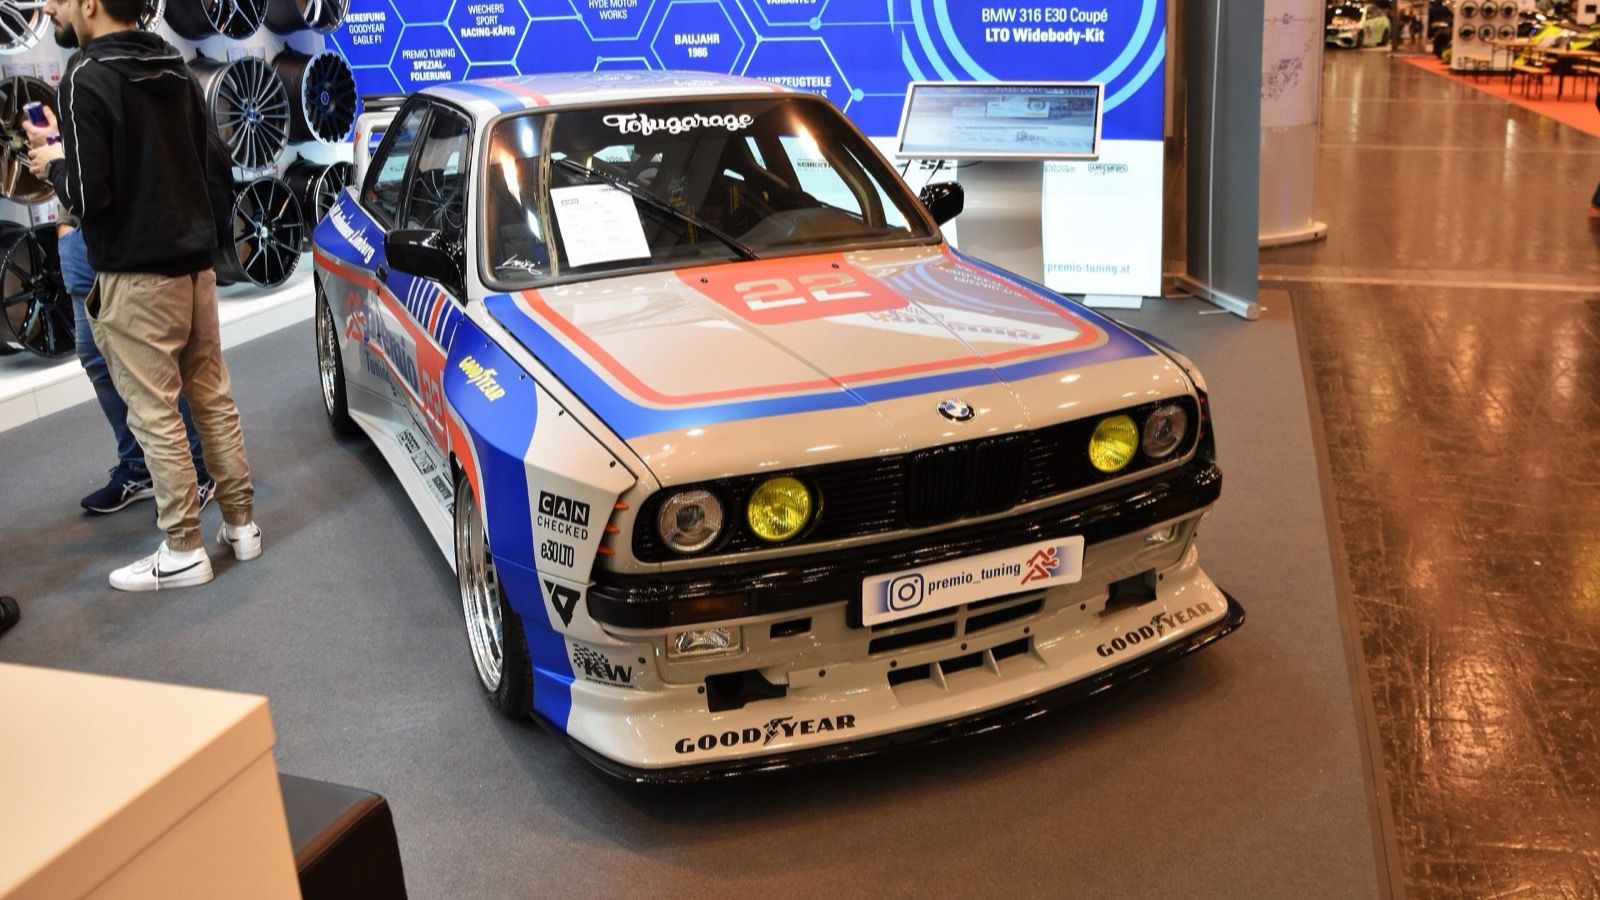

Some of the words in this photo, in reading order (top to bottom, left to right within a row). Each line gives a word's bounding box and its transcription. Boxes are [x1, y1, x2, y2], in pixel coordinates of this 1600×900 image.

[468, 4, 504, 15] WIECHERS
[599, 9, 628, 20] WORKS
[982, 8, 1017, 23] BMW
[1020, 8, 1042, 23] 316
[1045, 8, 1067, 23] E30
[1070, 7, 1108, 25] Coupé
[345, 12, 386, 23] BEREIFUNG
[476, 15, 498, 26] SPORT
[348, 23, 385, 34] GOODYEAR
[460, 25, 516, 38] RACING-KÄFIG
[353, 35, 374, 45] EAGLE
[374, 35, 382, 44] F1
[674, 33, 720, 45] BAUJAHR
[985, 28, 1010, 42] LTO
[1013, 28, 1105, 45] Widebody-Kit
[402, 49, 428, 59] PREMIO
[429, 48, 456, 58] TUNING
[688, 47, 708, 58] 1986
[413, 60, 447, 70] SPEZIAL-
[410, 70, 452, 82] FOLIERUNG
[602, 112, 754, 136] Tofugarage
[734, 272, 873, 311] 22
[459, 356, 506, 402] GOODYEAR
[540, 493, 589, 525] CAN
[537, 514, 589, 541] CHECKED
[928, 562, 1021, 596] premio_tuning
[1096, 602, 1213, 658] GOODYEAR
[583, 658, 632, 683] KW
[674, 714, 856, 754] GOODYEAR
